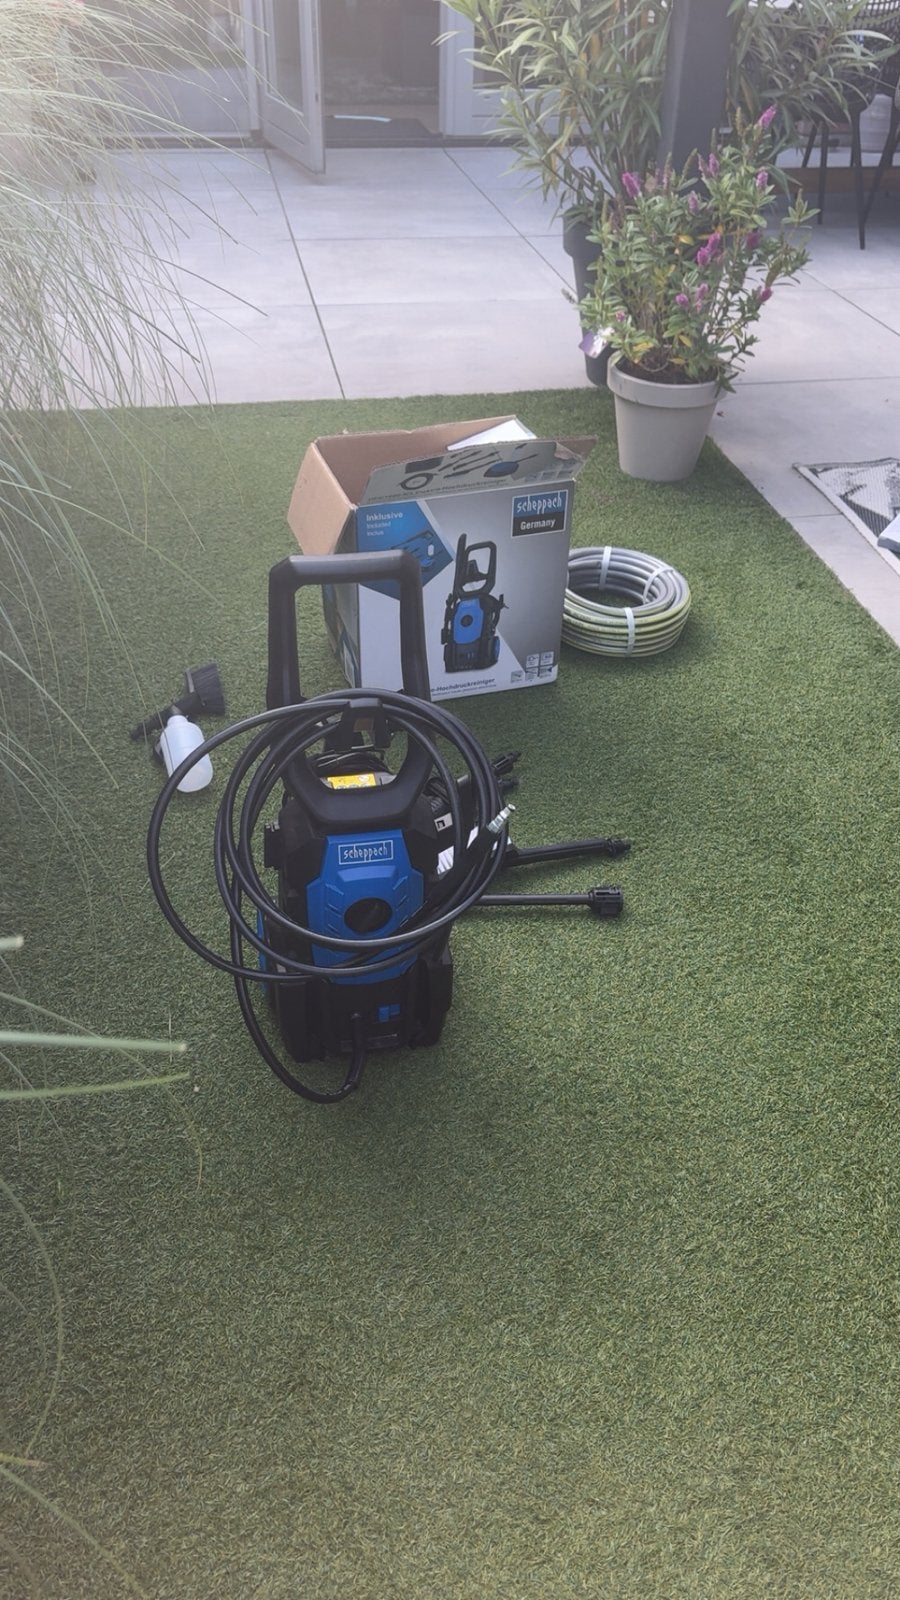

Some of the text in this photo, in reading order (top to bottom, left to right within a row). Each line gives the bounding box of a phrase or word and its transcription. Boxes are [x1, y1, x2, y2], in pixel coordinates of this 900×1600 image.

[516, 491, 562, 515] scheppach
[366, 512, 404, 521] Inklusive
[520, 519, 556, 531] Germany
[343, 842, 389, 863] scheppach
